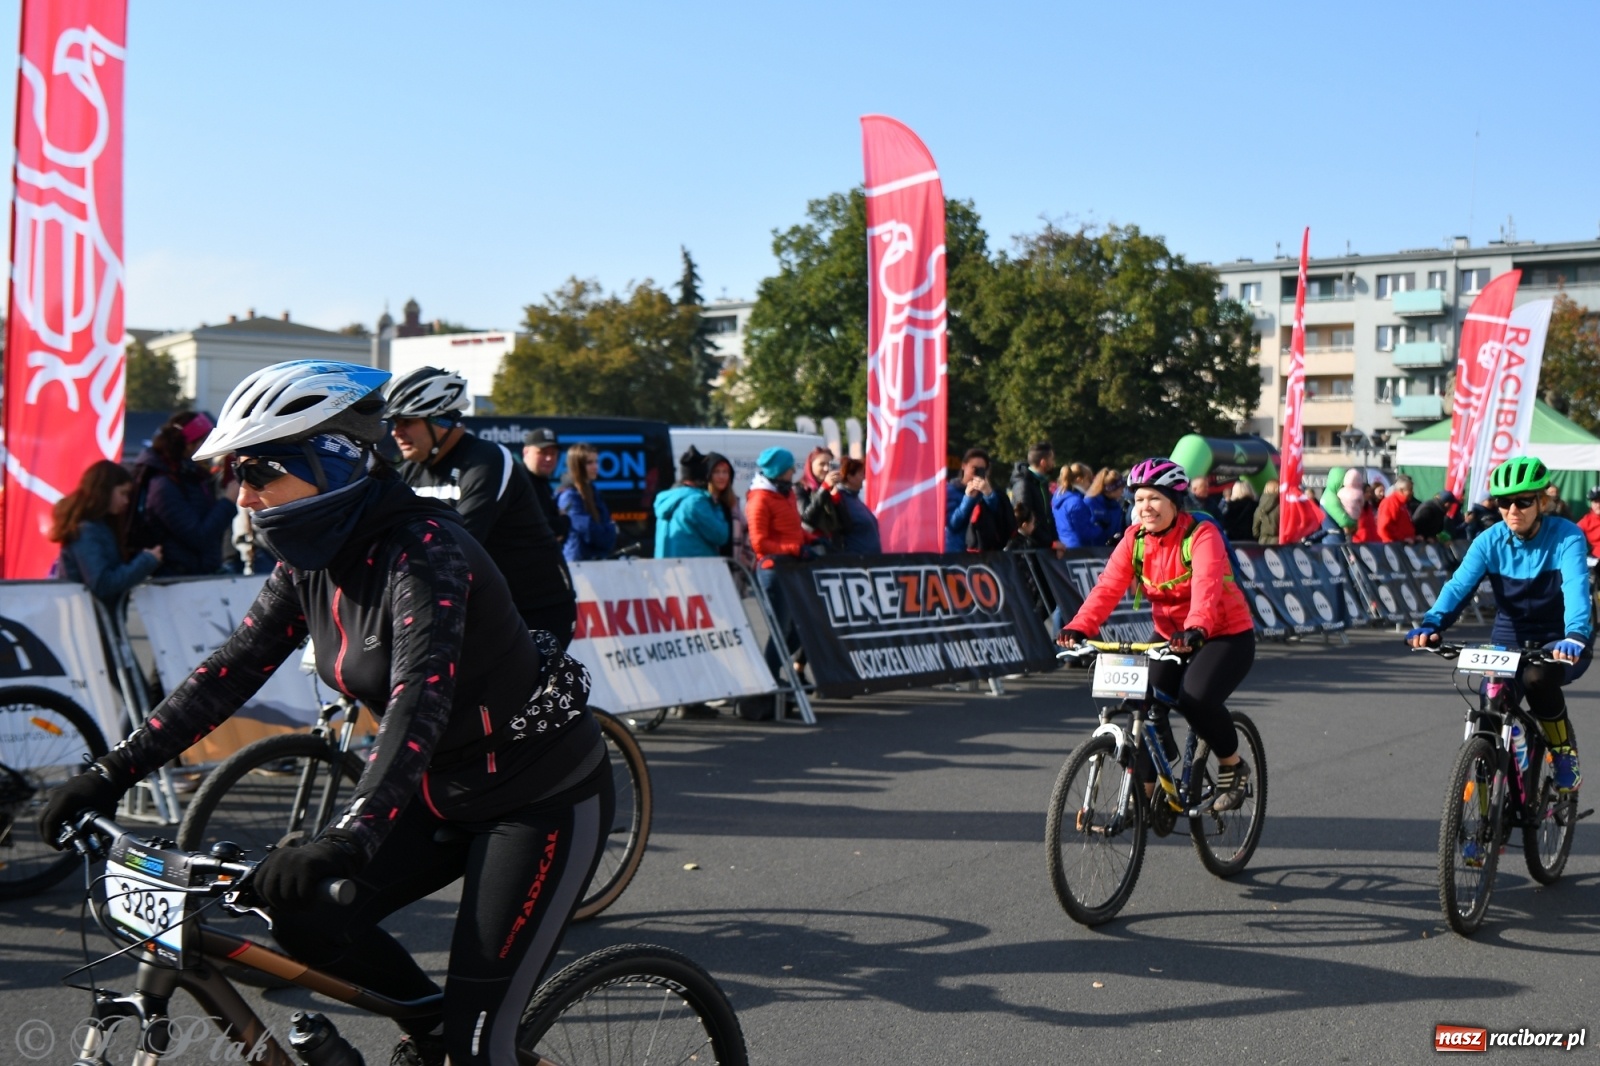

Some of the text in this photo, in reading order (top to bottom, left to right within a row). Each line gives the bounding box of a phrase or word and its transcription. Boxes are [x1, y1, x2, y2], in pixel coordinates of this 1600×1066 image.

[1488, 326, 1531, 466] RACIBÓ
[480, 425, 532, 443] atelie
[573, 594, 715, 640] AKIMA
[815, 567, 1002, 623] TREZADO
[605, 627, 743, 672] TAKE MORE FRIENDS
[849, 635, 1024, 680] USZCZELNIAMY NAJLEPSZYCH
[1470, 653, 1510, 666] 3179
[1103, 671, 1140, 685] 3059
[121, 882, 170, 930] 3283
